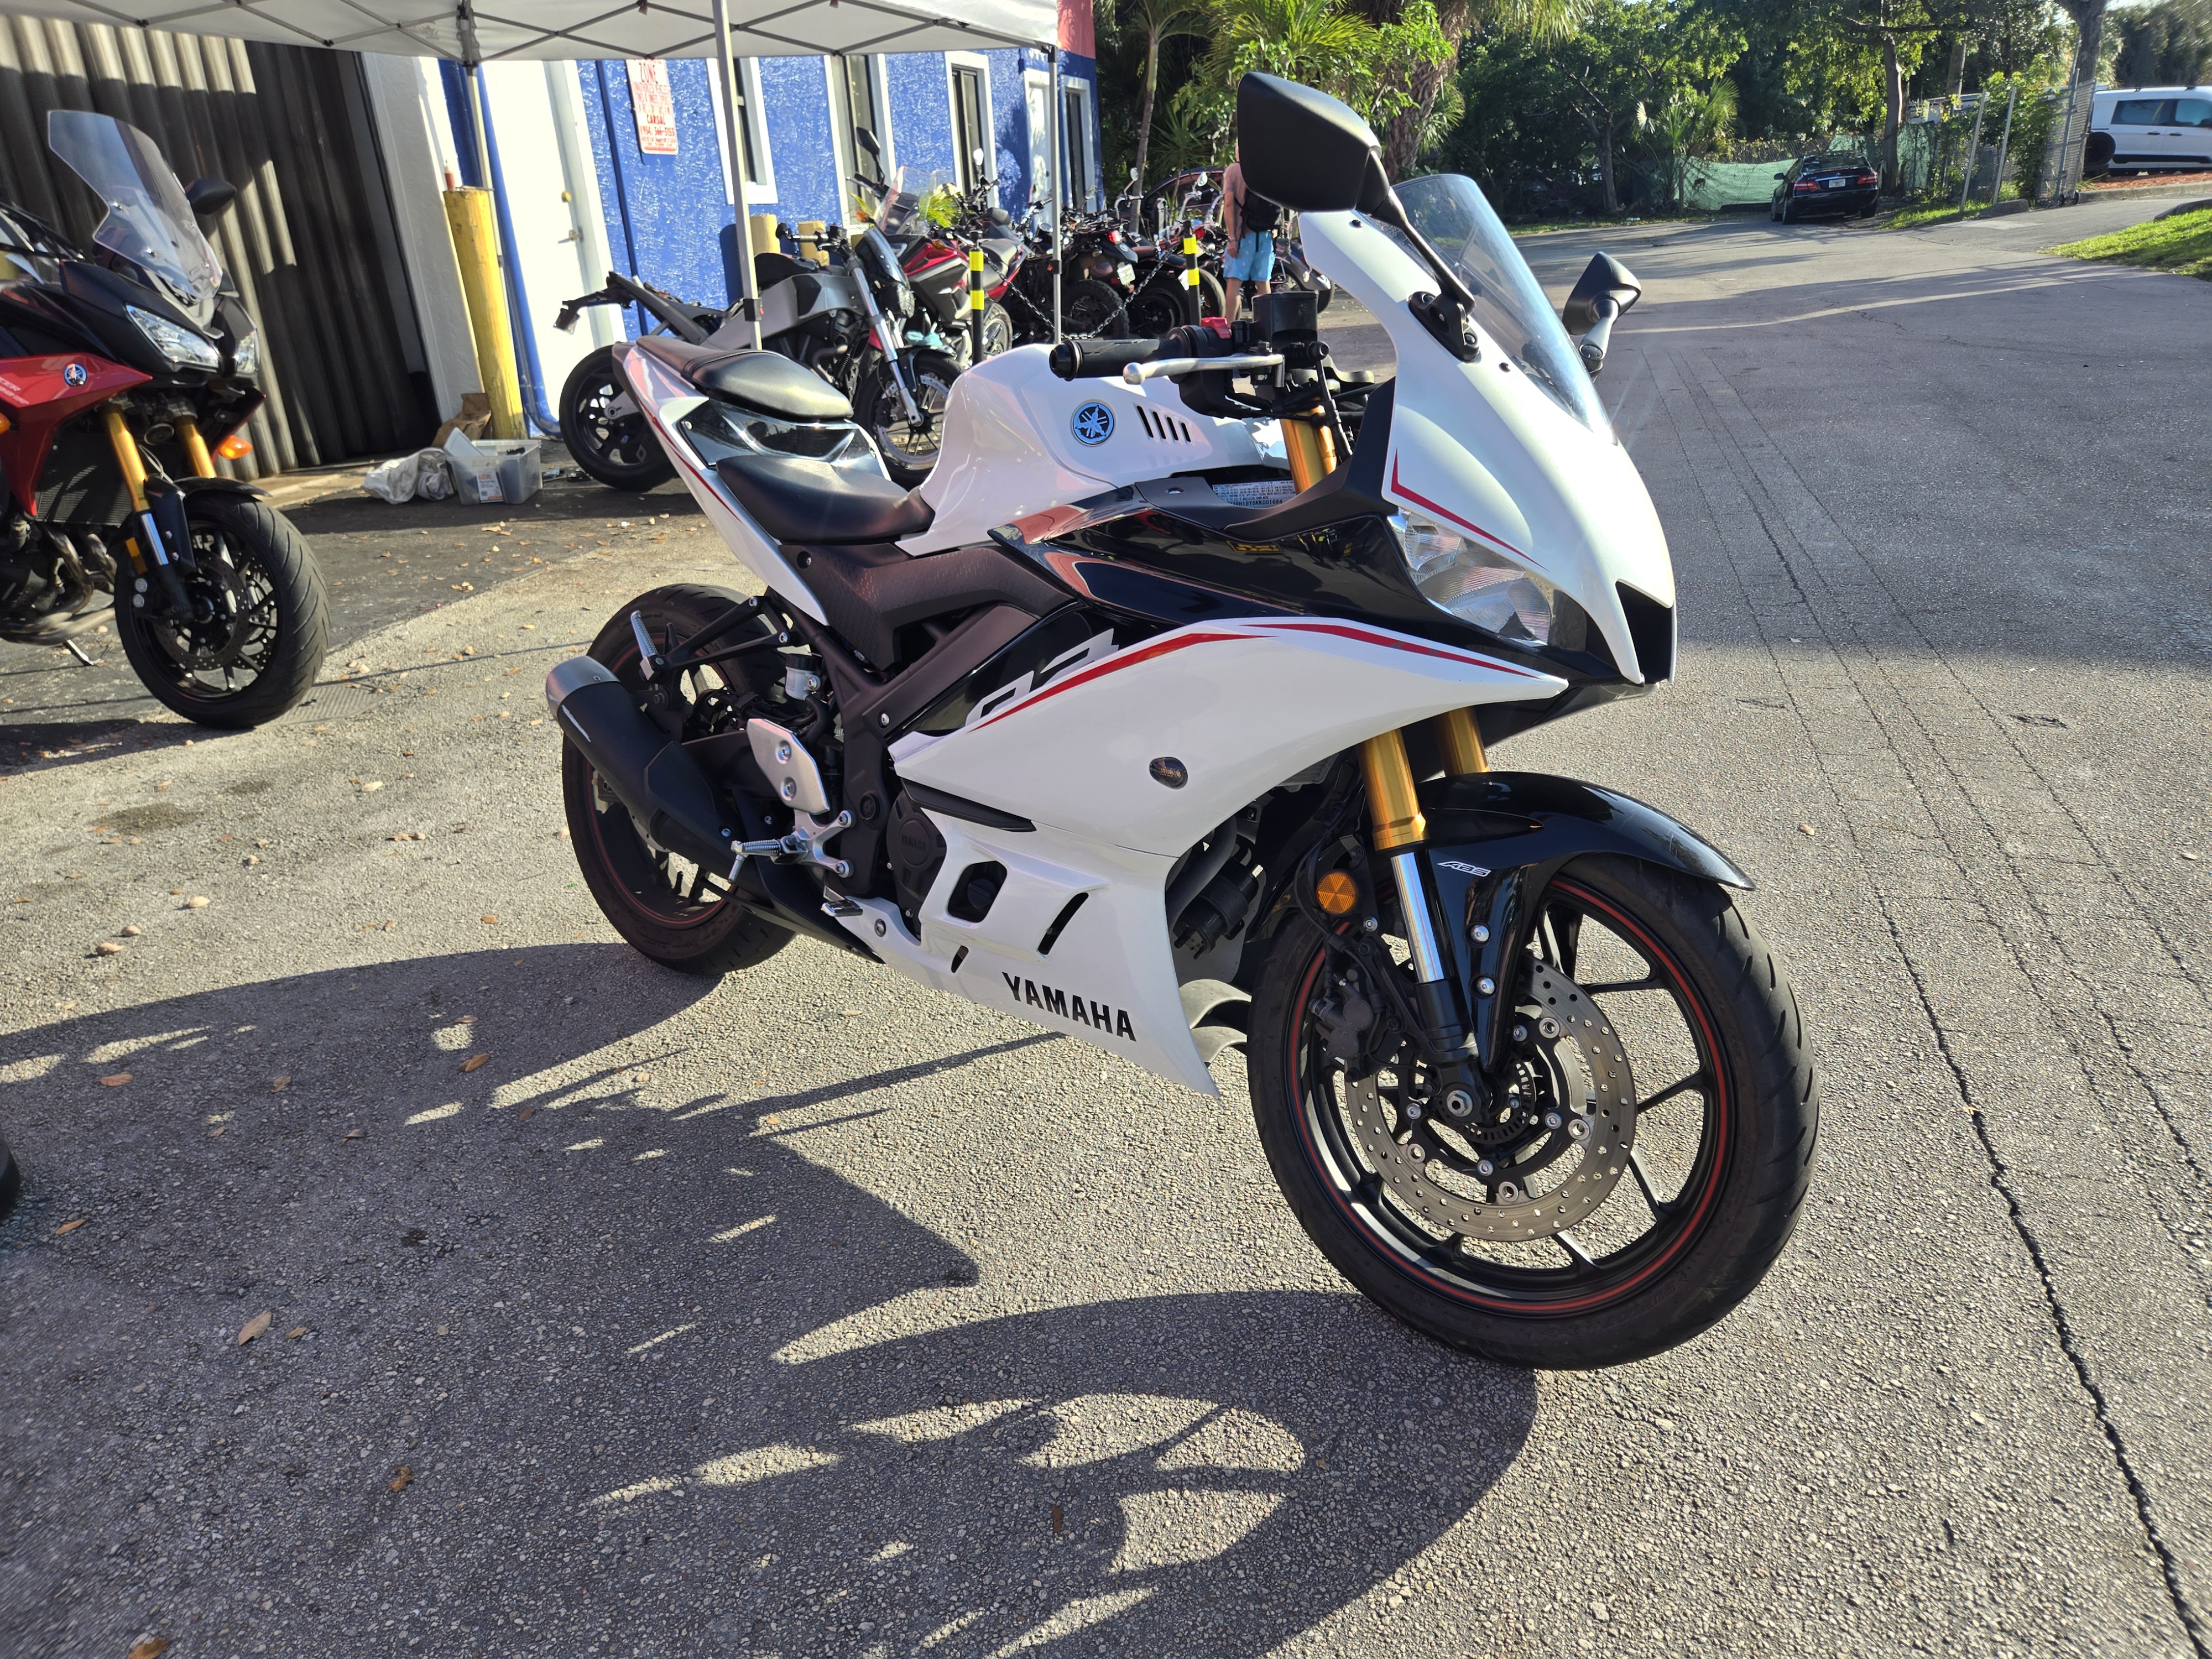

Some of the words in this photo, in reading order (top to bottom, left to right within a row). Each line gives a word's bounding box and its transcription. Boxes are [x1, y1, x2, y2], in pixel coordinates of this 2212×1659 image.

[638, 62, 658, 84] ZONE
[1437, 860, 1492, 878] ABS
[1001, 971, 1137, 1042] YAMAHA
